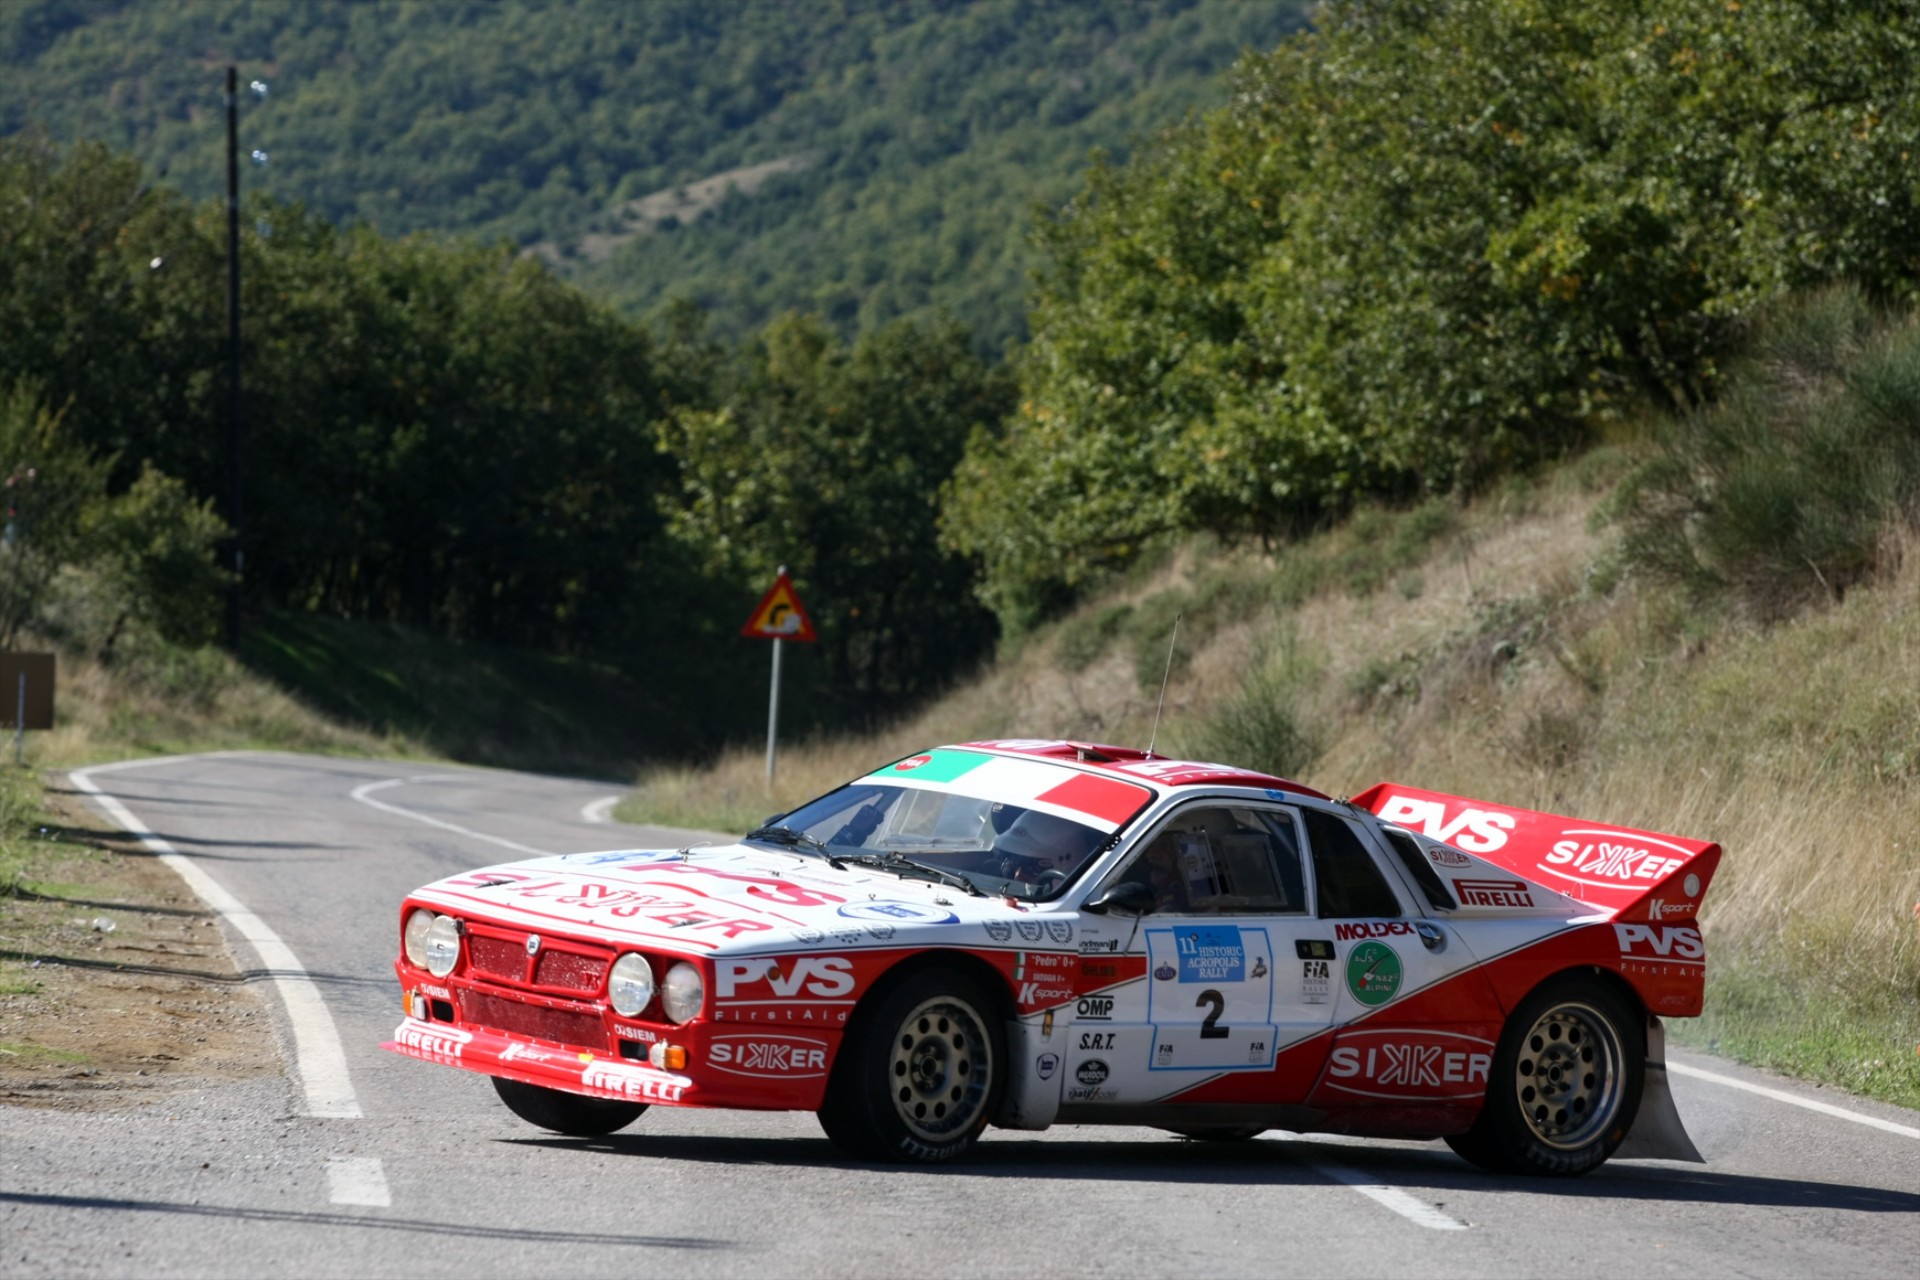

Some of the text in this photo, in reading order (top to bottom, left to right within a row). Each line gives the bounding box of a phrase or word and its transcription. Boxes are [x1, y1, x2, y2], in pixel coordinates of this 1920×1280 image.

[1376, 795, 1516, 853] PVS
[1451, 879, 1535, 907] PIRELLI
[1334, 921, 1416, 941] MOLDEX
[1612, 923, 1705, 958] PVS
[1188, 957, 1239, 968] ACROPOLIS
[1199, 946, 1242, 957] HISTORIC
[715, 957, 856, 997] PVS
[1199, 968, 1229, 979] RALLY
[1077, 1000, 1113, 1016] OMP
[1195, 989, 1230, 1039] 2
[395, 1016, 473, 1058] PIRELLI
[1079, 1033, 1117, 1051] S.R.T.
[709, 1043, 826, 1070] SIKKER
[1330, 1044, 1492, 1086] SIKKER
[582, 1060, 692, 1101] PIRELLI
